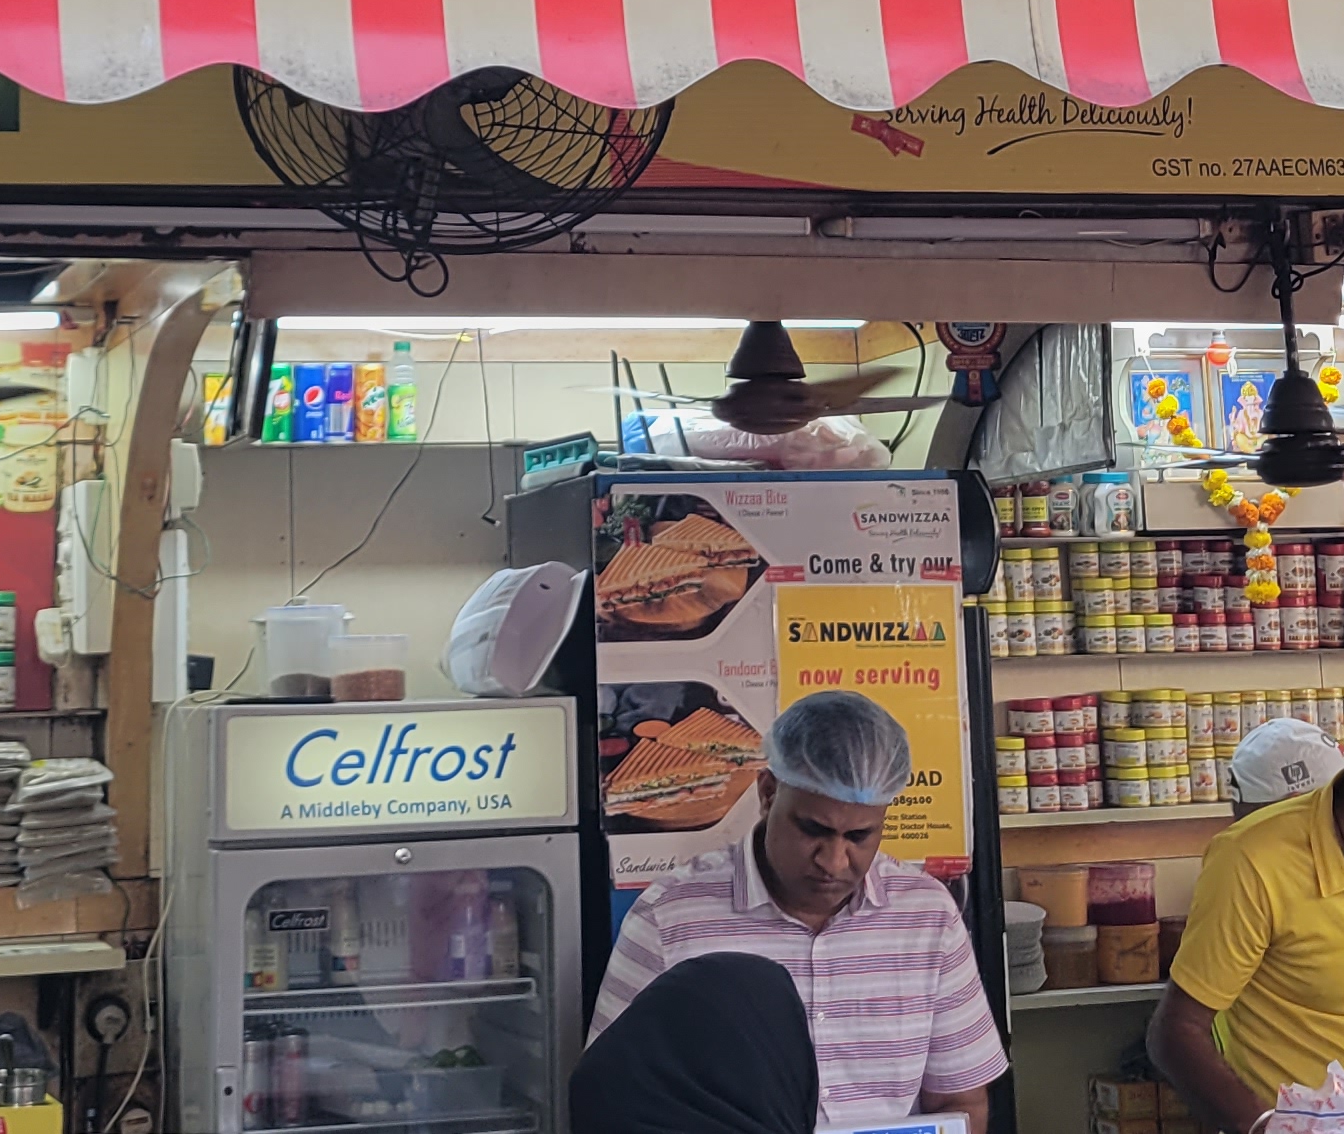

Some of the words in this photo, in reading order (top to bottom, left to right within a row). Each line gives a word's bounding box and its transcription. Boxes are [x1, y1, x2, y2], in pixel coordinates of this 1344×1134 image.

[976, 94, 1056, 128] Health
[1062, 96, 1193, 137] Deliciously!
[1151, 158, 1194, 177] GST
[1198, 160, 1228, 177] no.
[725, 491, 763, 505] Wizzaa
[766, 489, 787, 504] Bite
[860, 512, 950, 524] SANDWIZZAA
[809, 553, 862, 575] Come
[869, 554, 882, 573] &
[889, 553, 916, 577] try
[924, 556, 953, 573] our
[717, 659, 766, 677] Tandoori
[799, 667, 843, 686] now
[854, 660, 940, 691] serving
[285, 723, 517, 788] Celfrost
[280, 804, 293, 819] A
[300, 800, 382, 819] Middleby
[387, 796, 471, 817] Company,
[477, 794, 512, 810] USA
[900, 823, 925, 831] Doctor
[271, 911, 326, 930] Celfrost
